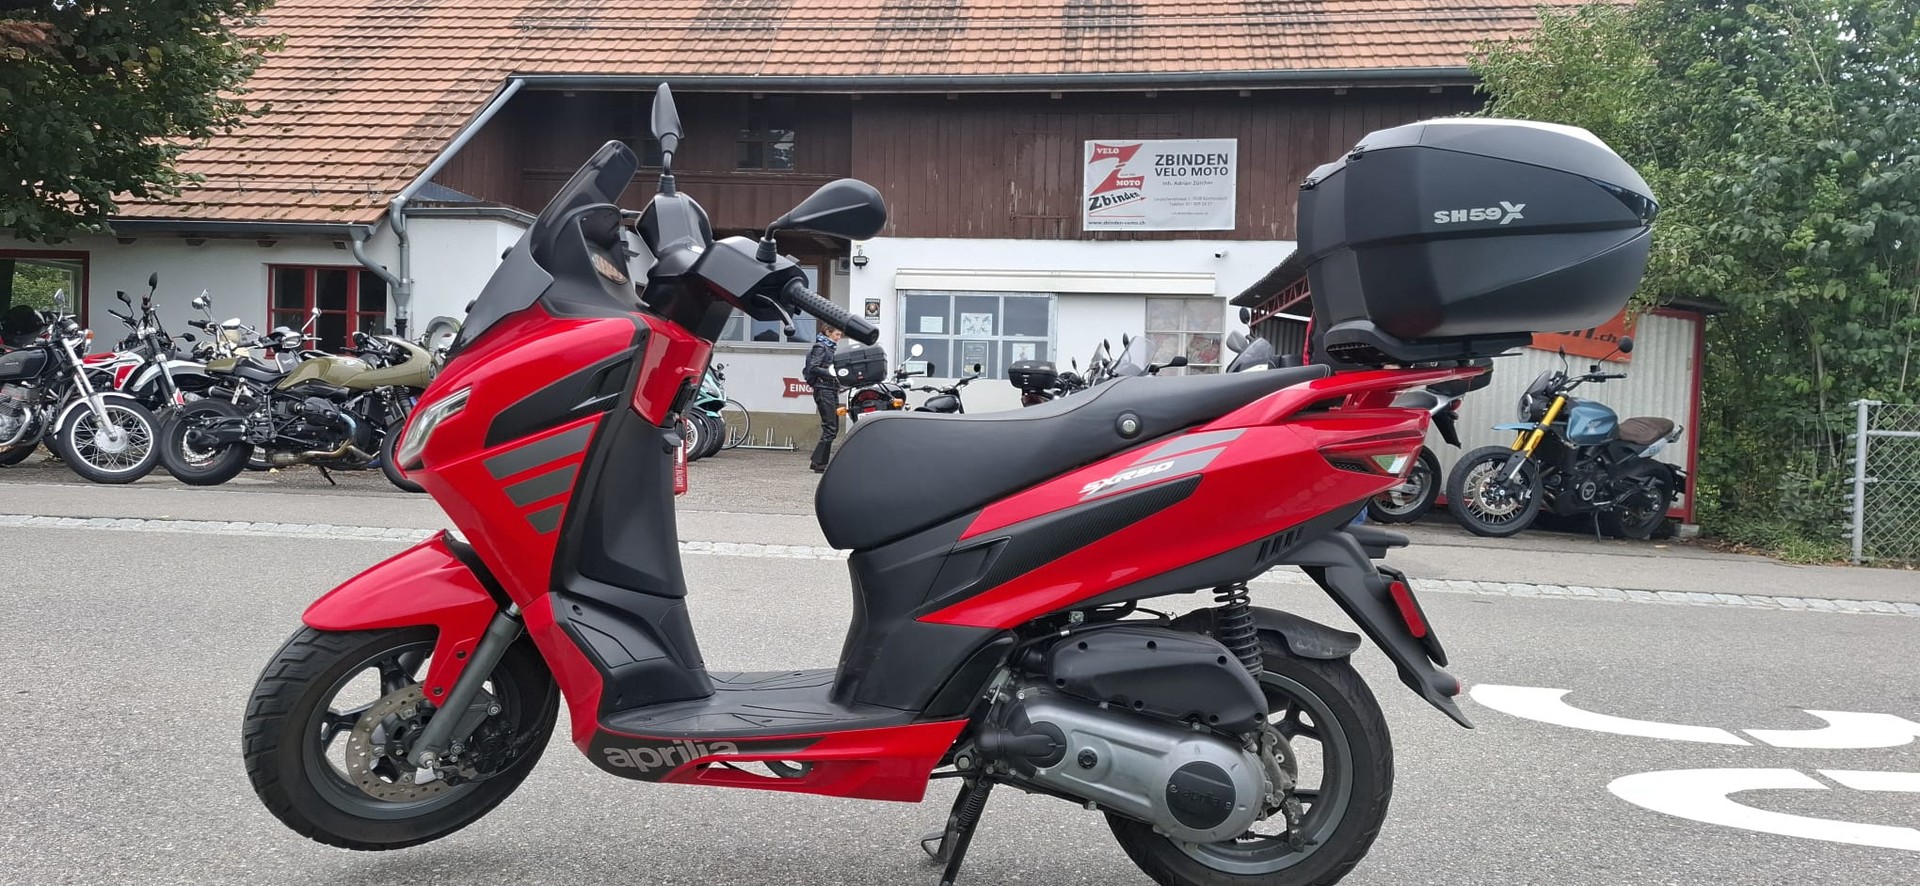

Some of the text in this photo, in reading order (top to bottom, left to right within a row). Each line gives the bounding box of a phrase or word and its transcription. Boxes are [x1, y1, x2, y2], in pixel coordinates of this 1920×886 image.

[1155, 153, 1229, 166] ZBINDEN
[1155, 166, 1229, 176] VELO MOTO
[1088, 191, 1141, 211] Zbinden
[1077, 460, 1175, 501] SXR50
[603, 739, 739, 773] aprilia
